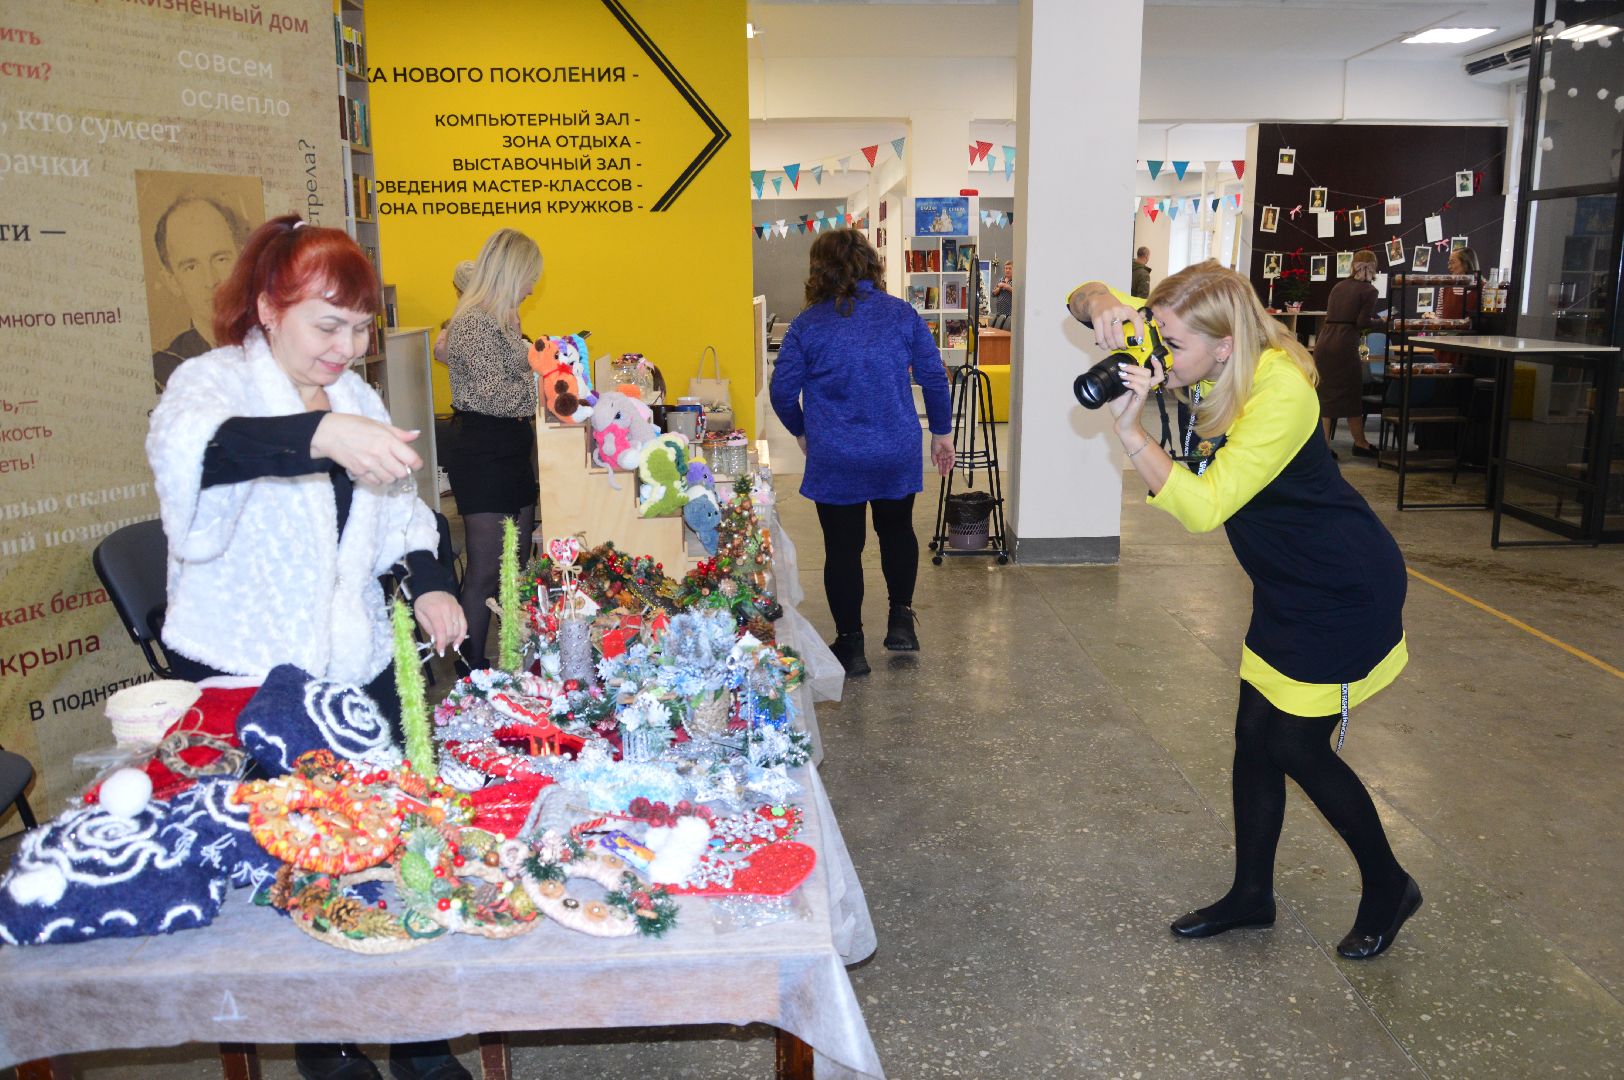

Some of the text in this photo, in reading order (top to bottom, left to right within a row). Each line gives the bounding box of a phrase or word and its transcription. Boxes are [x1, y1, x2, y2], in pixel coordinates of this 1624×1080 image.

[121, 0, 308, 34] изненный дом
[0, 61, 52, 81] сти?
[178, 49, 272, 79] совсем
[393, 67, 483, 83] НОВОГО
[490, 67, 626, 83] ПОКОЛЕНИЯ
[182, 88, 290, 117] ослепло
[17, 110, 181, 143] кто сумеет
[435, 109, 590, 127] КОМПЬЮТЕРНЫЙ
[595, 113, 630, 126] ЗАЛ
[502, 135, 551, 148] ЗОНА
[556, 135, 631, 150] ОТДЫХА
[453, 154, 591, 171] ВЫСТАВОЧНЫЙ
[596, 157, 631, 170] ЗАЛ
[473, 178, 632, 193] МАСТЕР-КЛАССОВ
[378, 202, 418, 215] ОНА
[422, 201, 541, 217] ПРОВЕДЕНИЯ
[547, 200, 634, 213] КРУЖКОВ
[0, 307, 122, 329] много пепла!
[0, 425, 53, 443] кость
[65, 481, 149, 509] склеит
[0, 602, 46, 628] как
[0, 634, 101, 677] крыла
[28, 700, 45, 722] В
